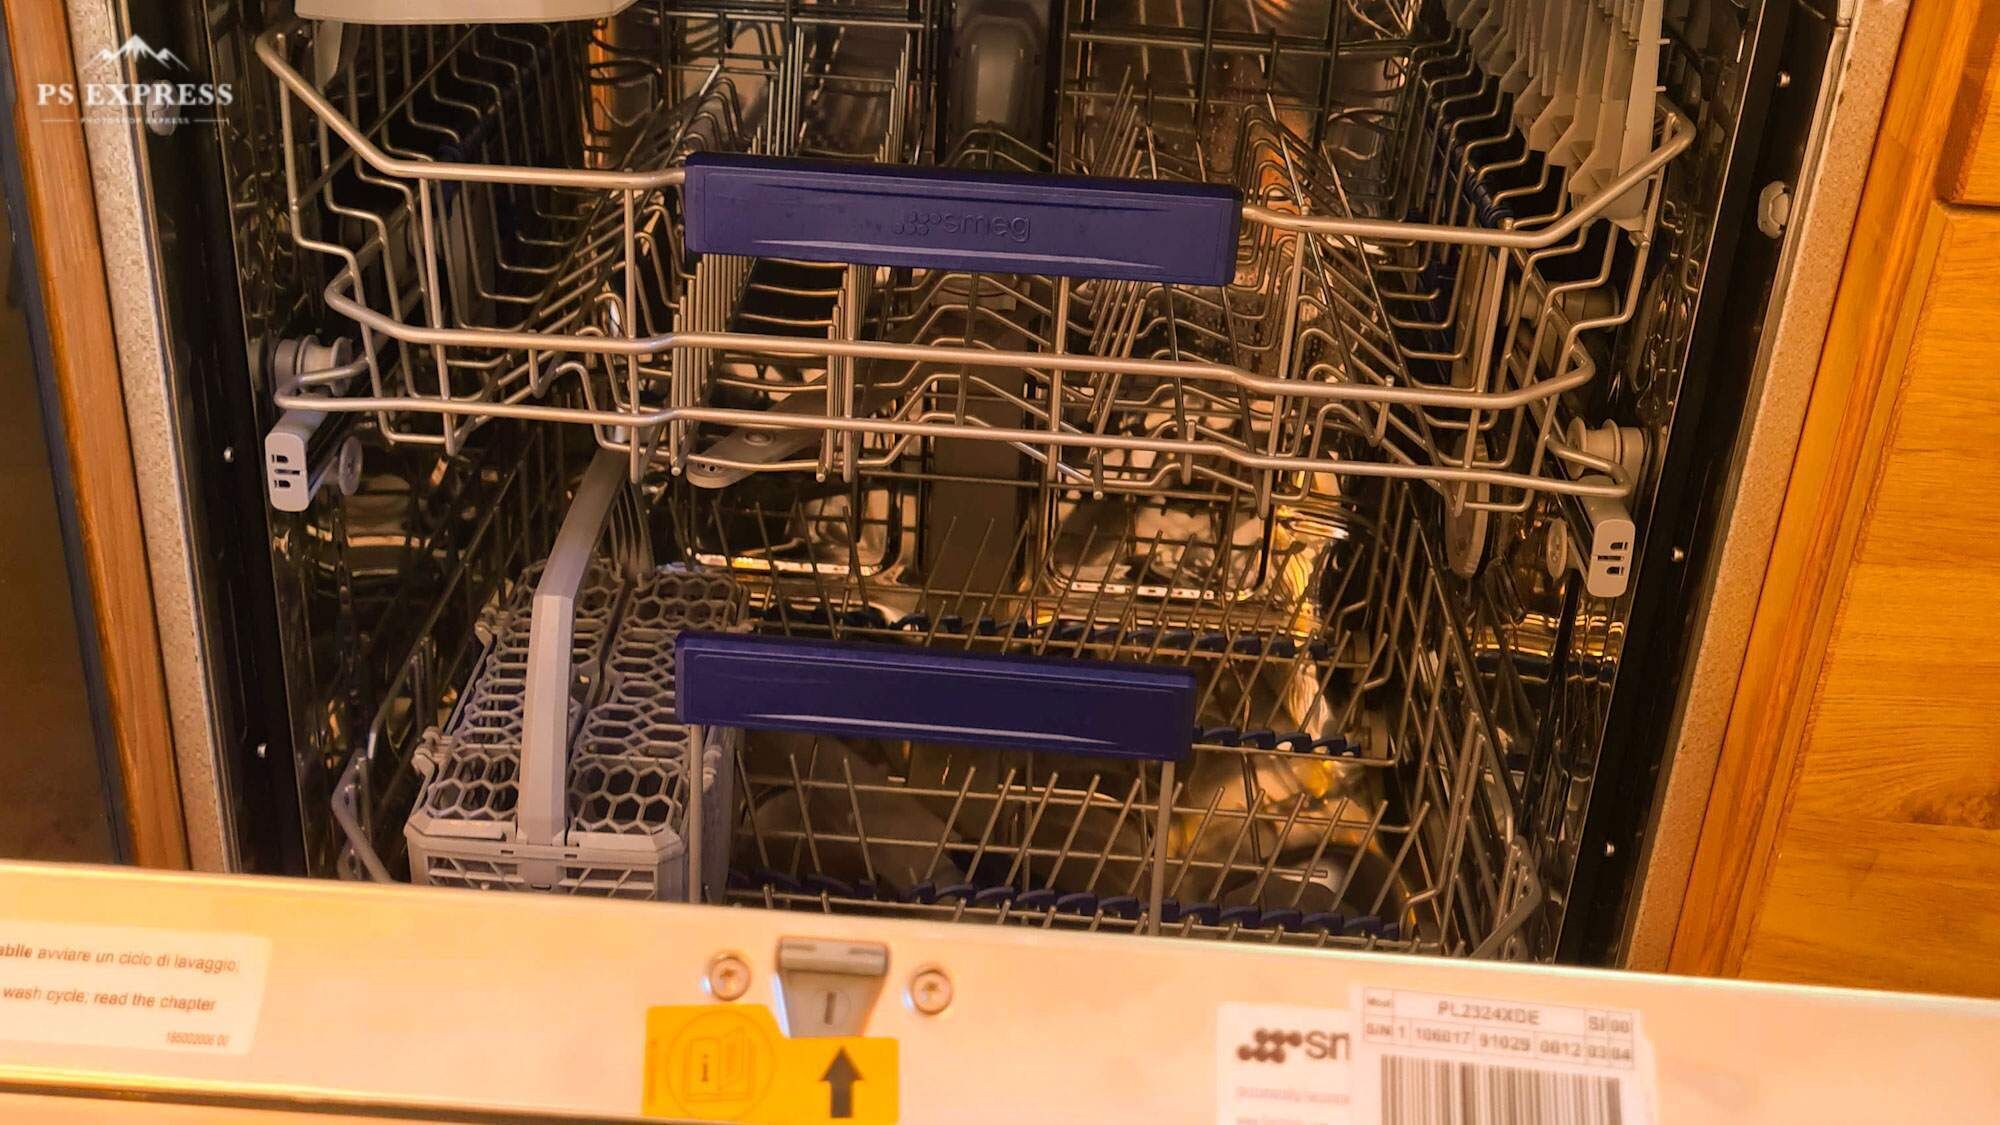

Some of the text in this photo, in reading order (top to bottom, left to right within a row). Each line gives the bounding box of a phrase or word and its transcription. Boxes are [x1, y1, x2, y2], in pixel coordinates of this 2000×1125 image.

[943, 213, 1031, 242] smeg
[38, 948, 91, 962] avviare
[96, 951, 114, 964] un
[157, 954, 170, 968] di
[3, 985, 42, 1000] wash
[93, 990, 128, 1006] read
[132, 993, 156, 1008] the
[160, 994, 217, 1013] chapter
[1437, 1000, 1541, 1026] PL2324XDE
